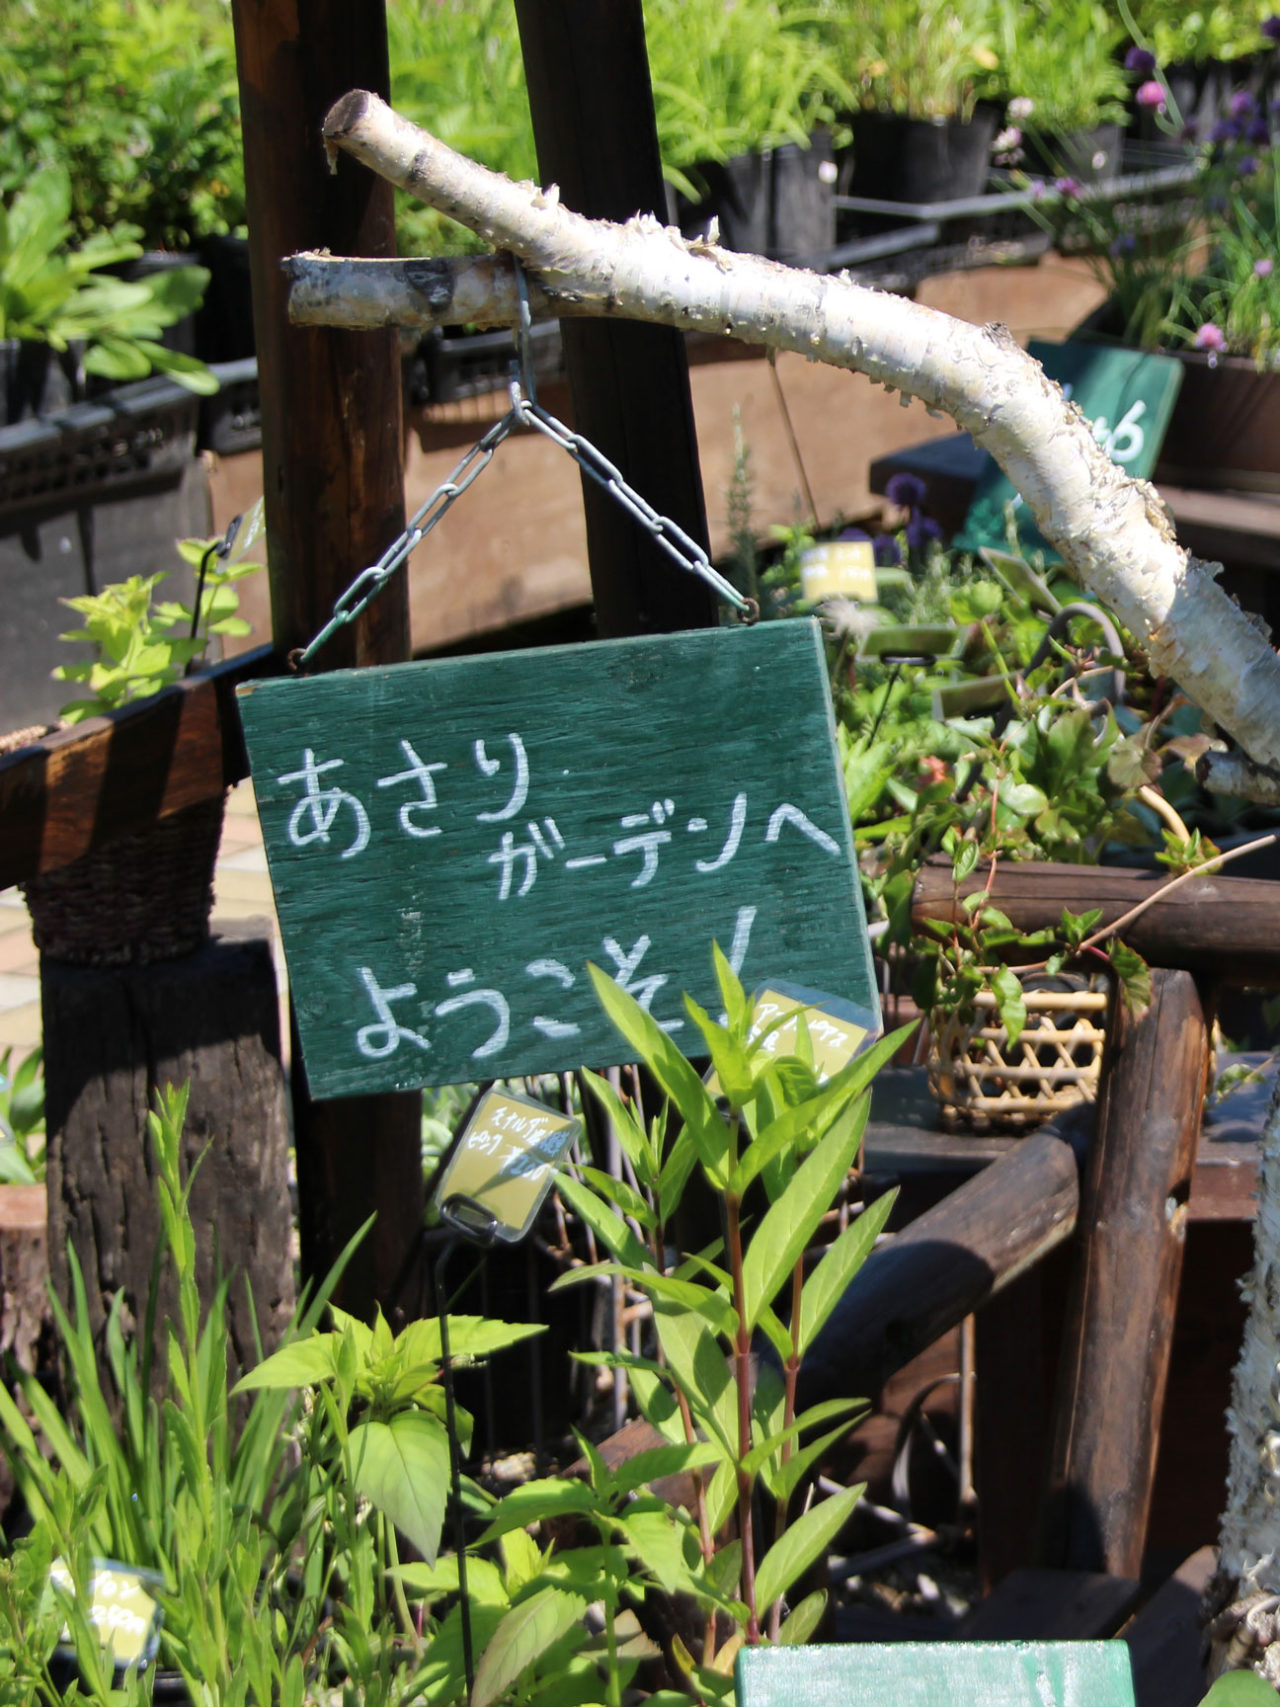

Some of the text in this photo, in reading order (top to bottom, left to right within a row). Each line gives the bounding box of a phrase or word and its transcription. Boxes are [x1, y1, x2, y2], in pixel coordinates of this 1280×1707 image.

[277, 733, 529, 859] あさり
[488, 793, 841, 900] ガーデンへ
